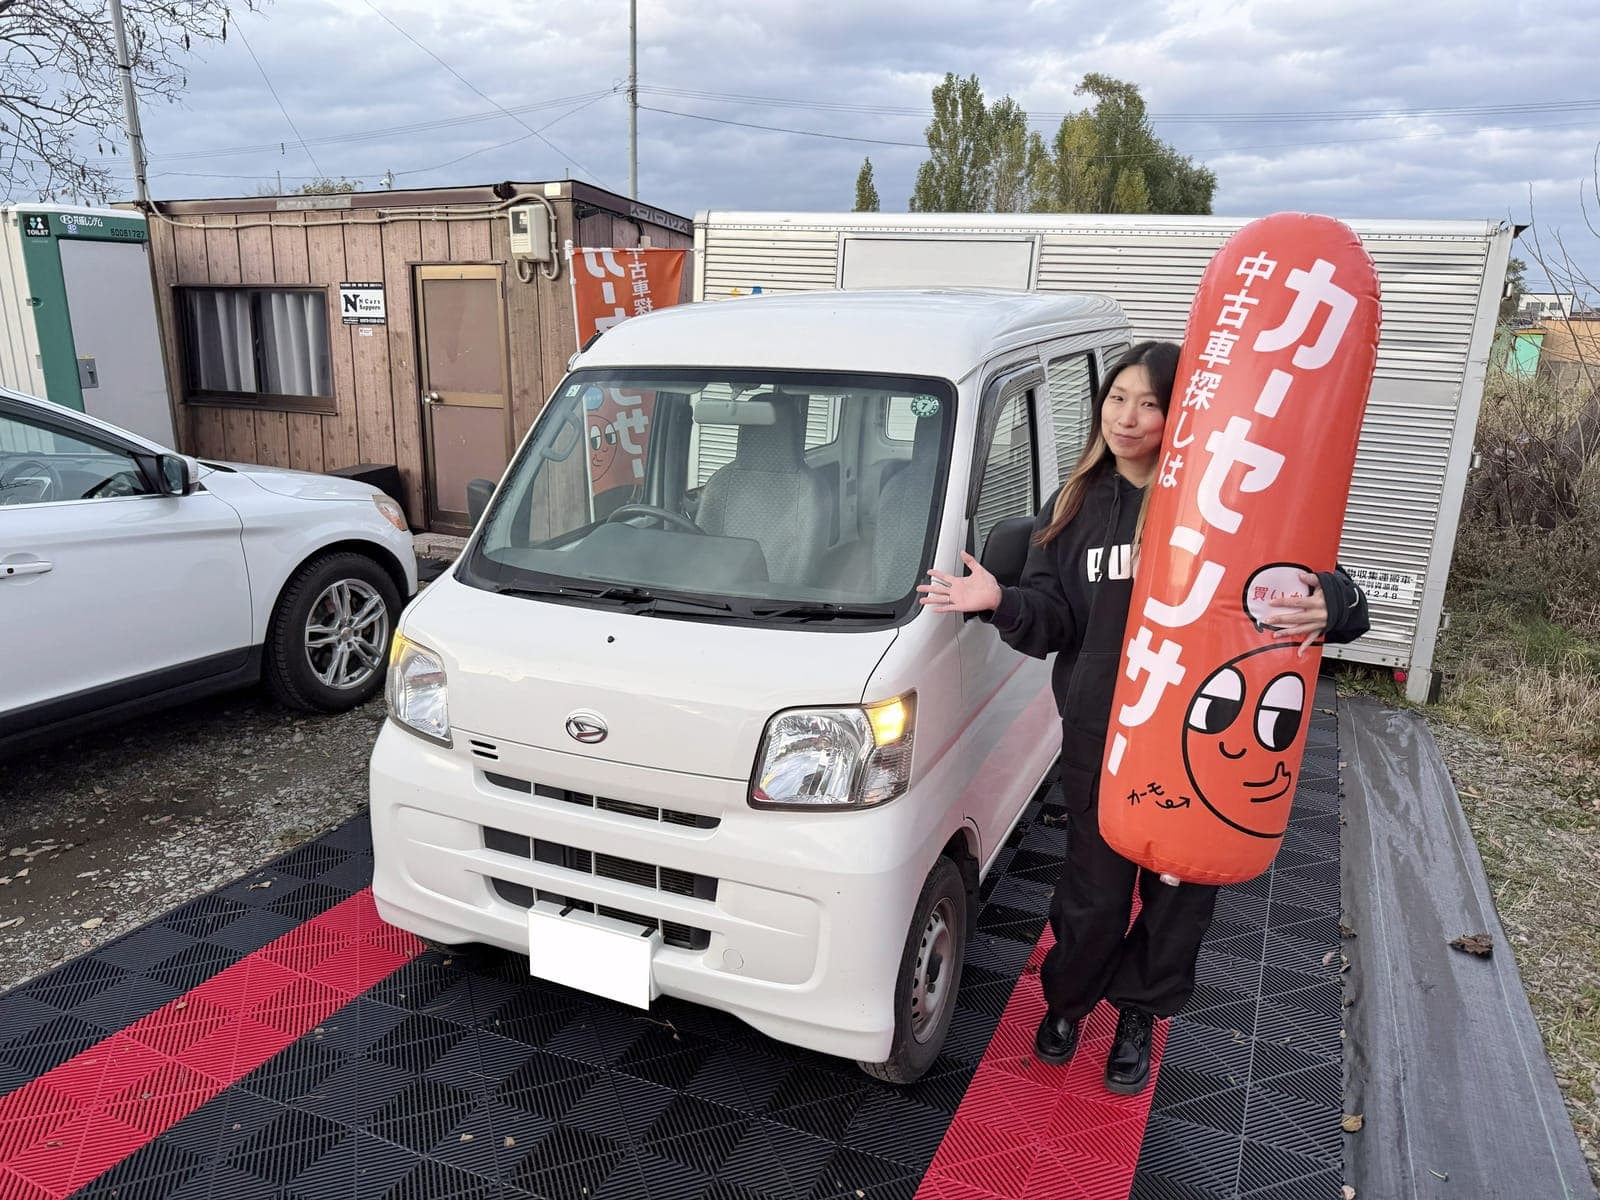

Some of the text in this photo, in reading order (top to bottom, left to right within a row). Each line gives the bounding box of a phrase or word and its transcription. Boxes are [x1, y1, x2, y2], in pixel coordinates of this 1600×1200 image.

[342, 294, 360, 312] N
[1158, 251, 1278, 489] 中古車探しは
[1106, 258, 1358, 777] カーセンサー
[1127, 782, 1165, 805] カーモ
